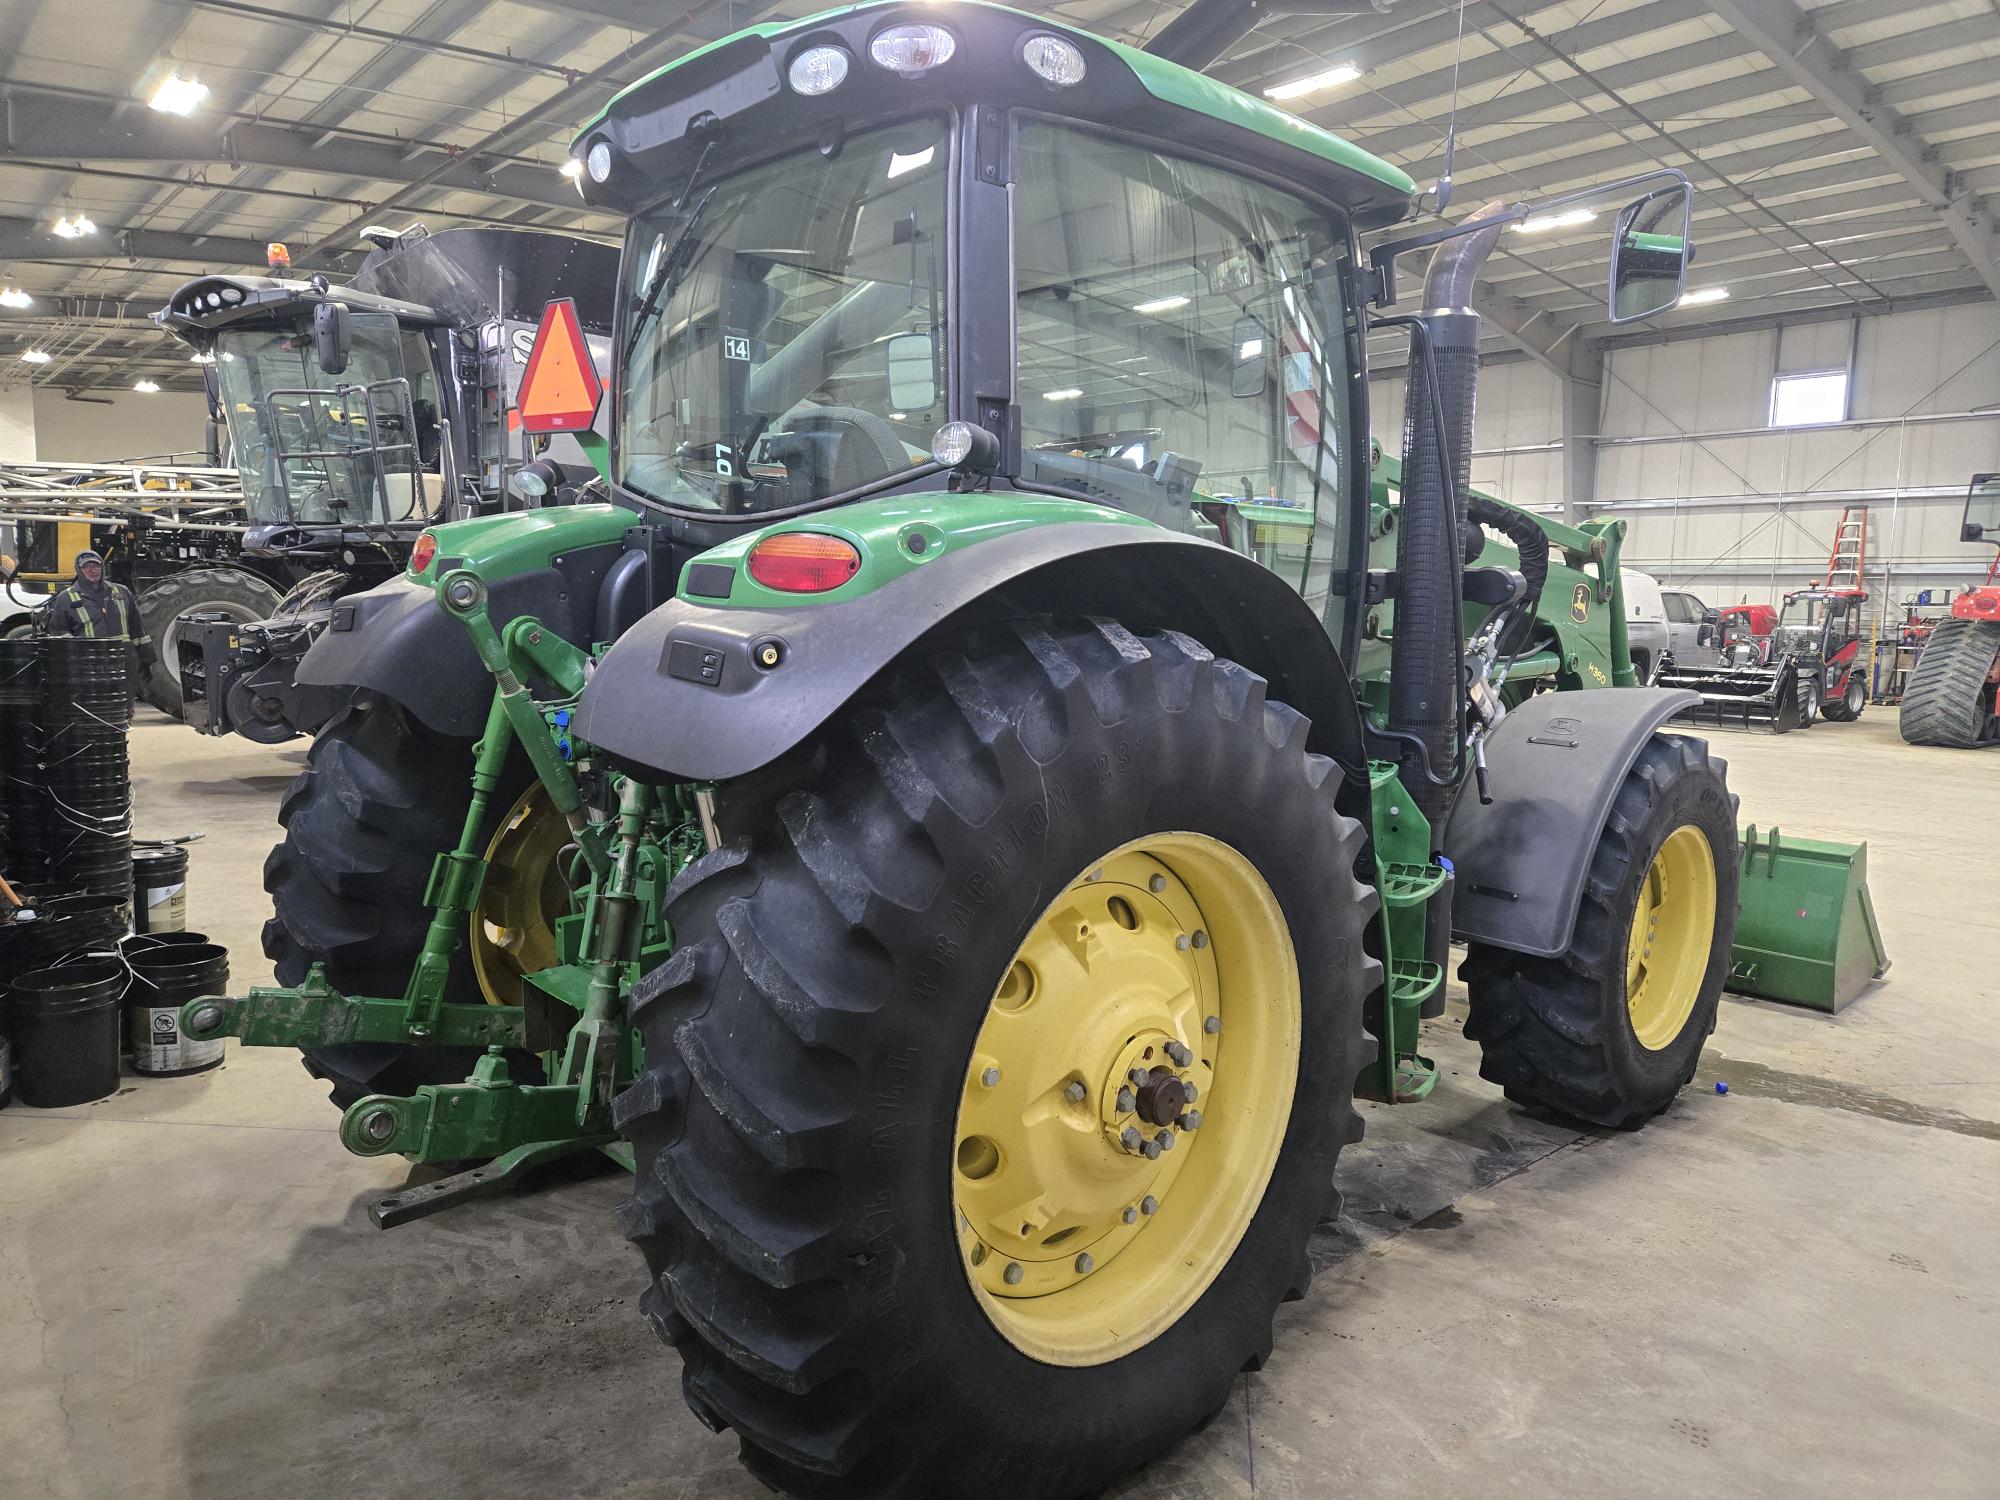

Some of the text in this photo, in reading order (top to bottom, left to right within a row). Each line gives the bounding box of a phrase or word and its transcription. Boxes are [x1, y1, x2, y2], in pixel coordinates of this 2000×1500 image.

[727, 339, 747, 358] 14
[1588, 661, 1606, 685] H360
[908, 783, 1070, 1004] TRACTION
